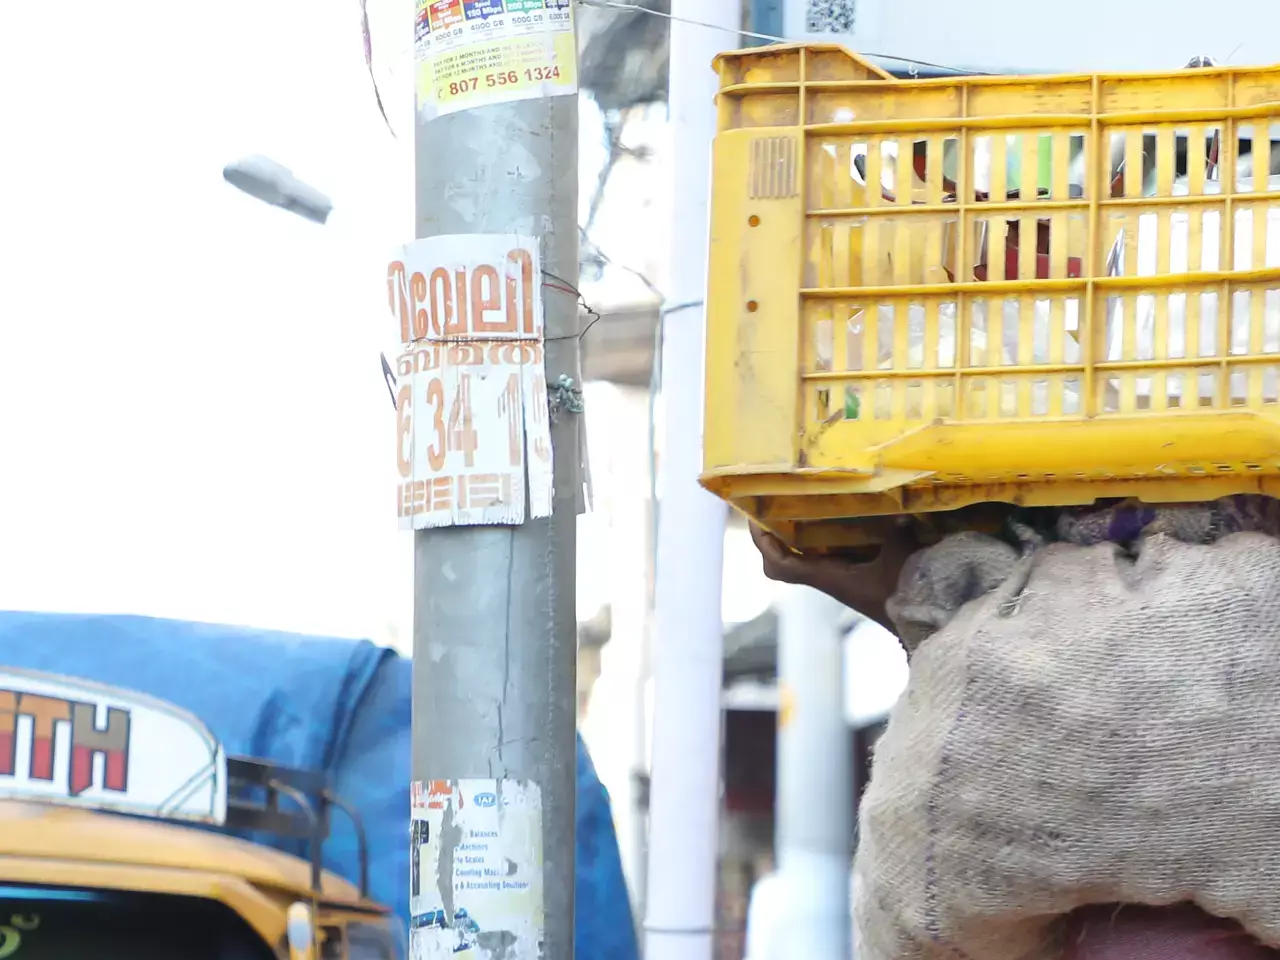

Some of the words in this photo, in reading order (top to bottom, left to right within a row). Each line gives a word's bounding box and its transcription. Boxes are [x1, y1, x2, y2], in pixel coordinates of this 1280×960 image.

[449, 77, 478, 95] 807
[485, 70, 519, 87] 556
[524, 65, 560, 81] 1324
